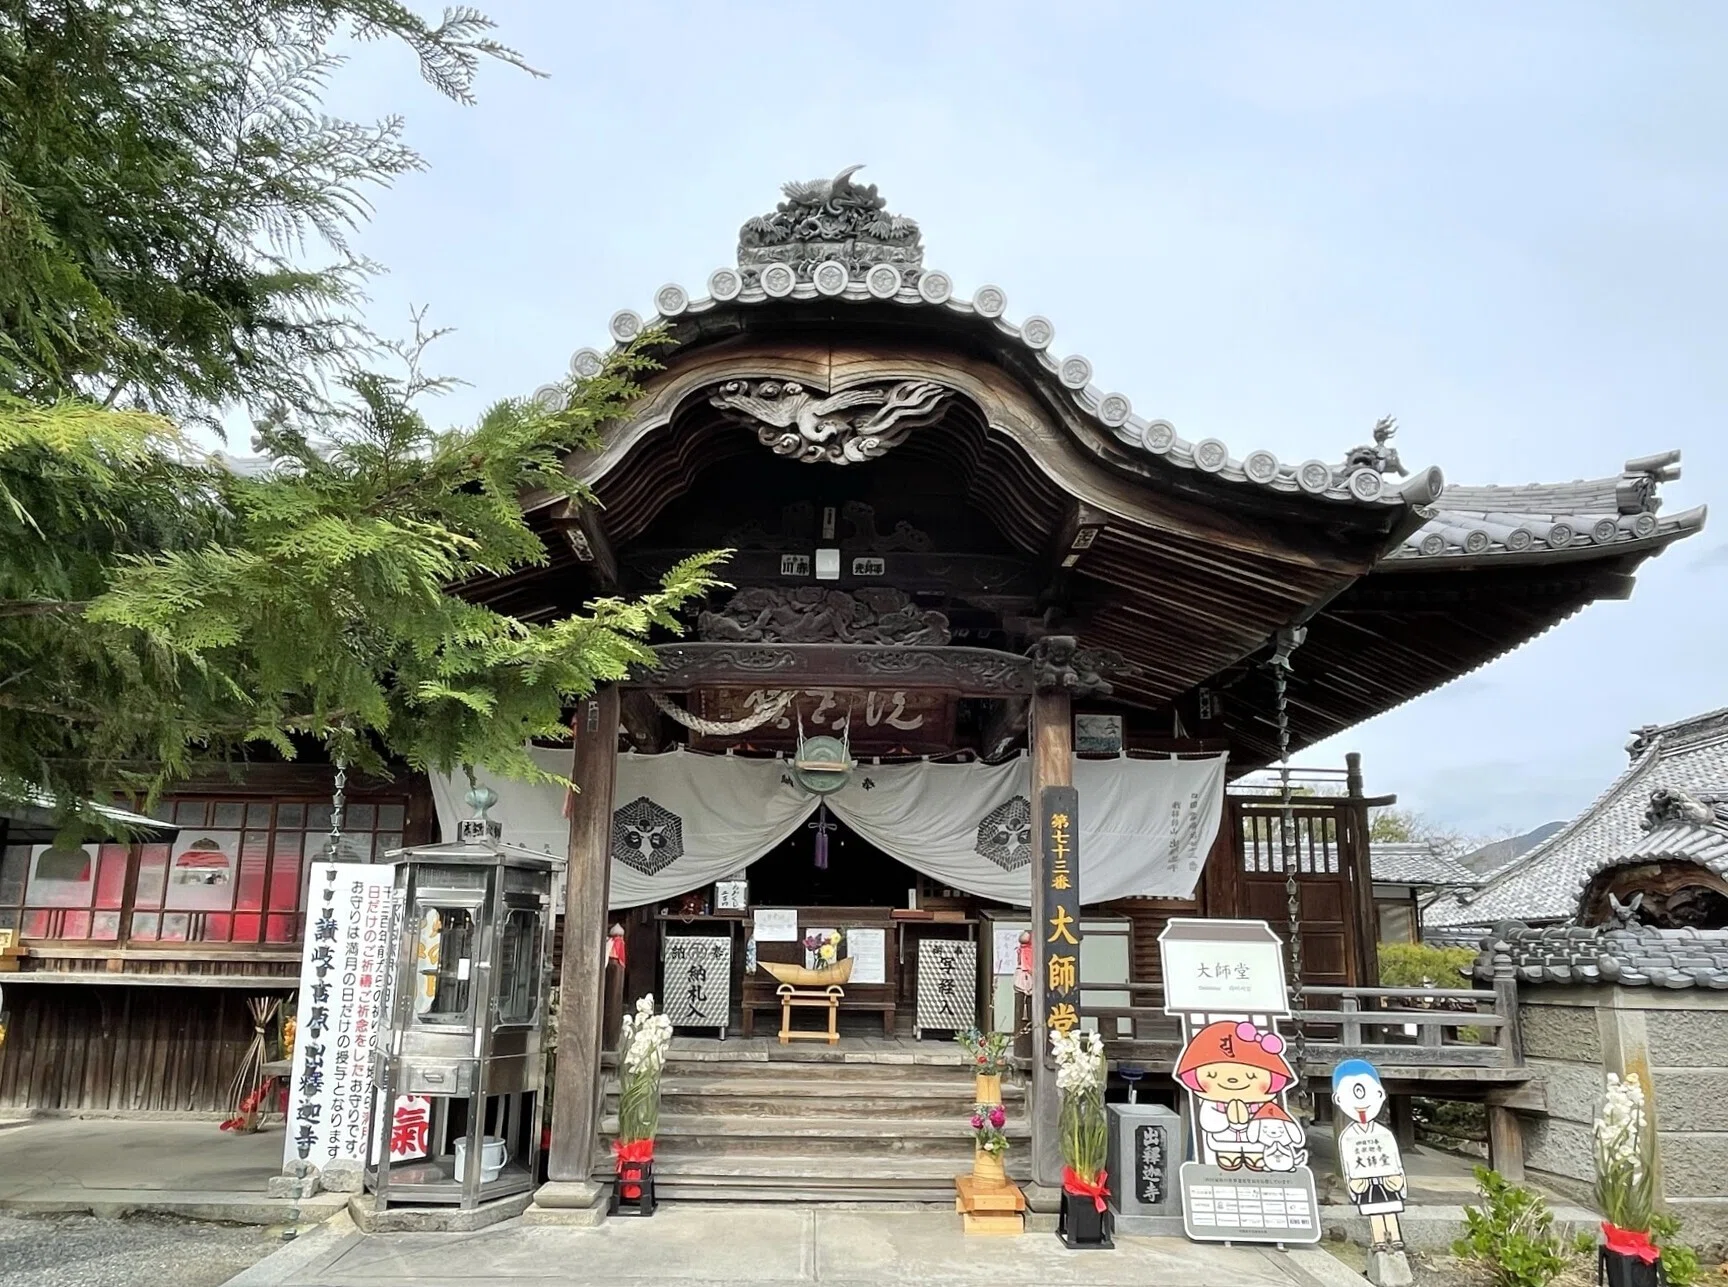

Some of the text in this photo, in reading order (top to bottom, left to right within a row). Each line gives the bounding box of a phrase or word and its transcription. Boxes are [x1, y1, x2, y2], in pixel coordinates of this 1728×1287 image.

[1047, 813, 1079, 1040] 第七十三番 大師堂
[686, 965, 707, 1018] 納札入
[938, 956, 956, 1016] 写経入
[1197, 961, 1251, 980] 大師堂
